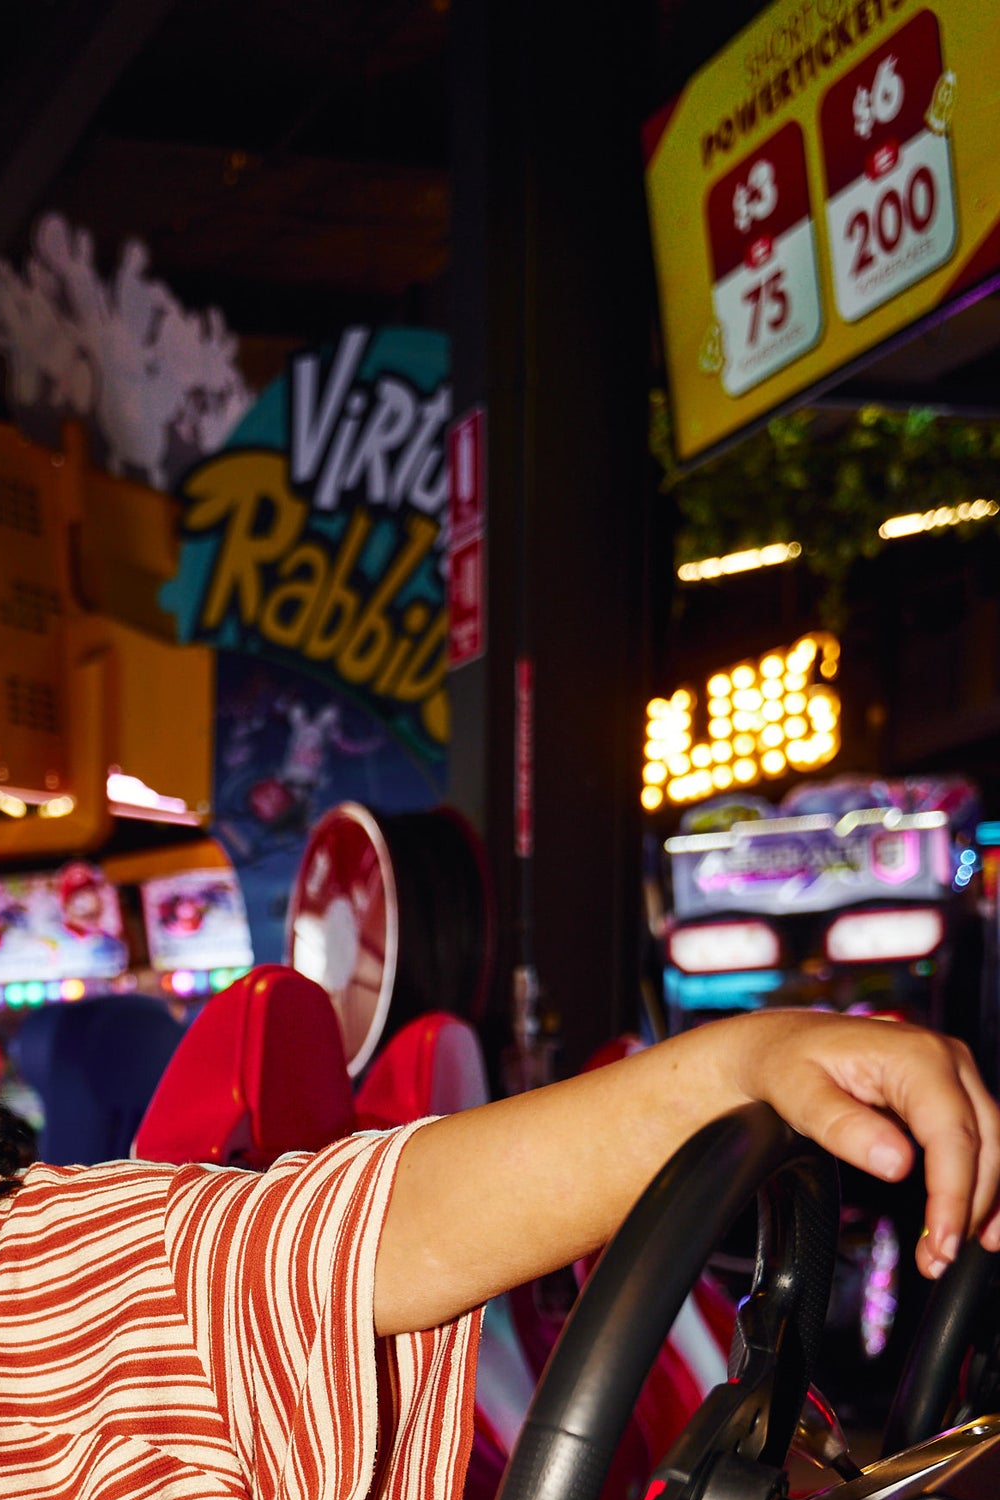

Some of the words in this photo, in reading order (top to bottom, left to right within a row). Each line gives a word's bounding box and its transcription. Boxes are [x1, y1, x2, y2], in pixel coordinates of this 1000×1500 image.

[852, 54, 904, 139] $6
[733, 159, 778, 232] $3
[845, 166, 935, 277] 200
[741, 269, 790, 346] 75
